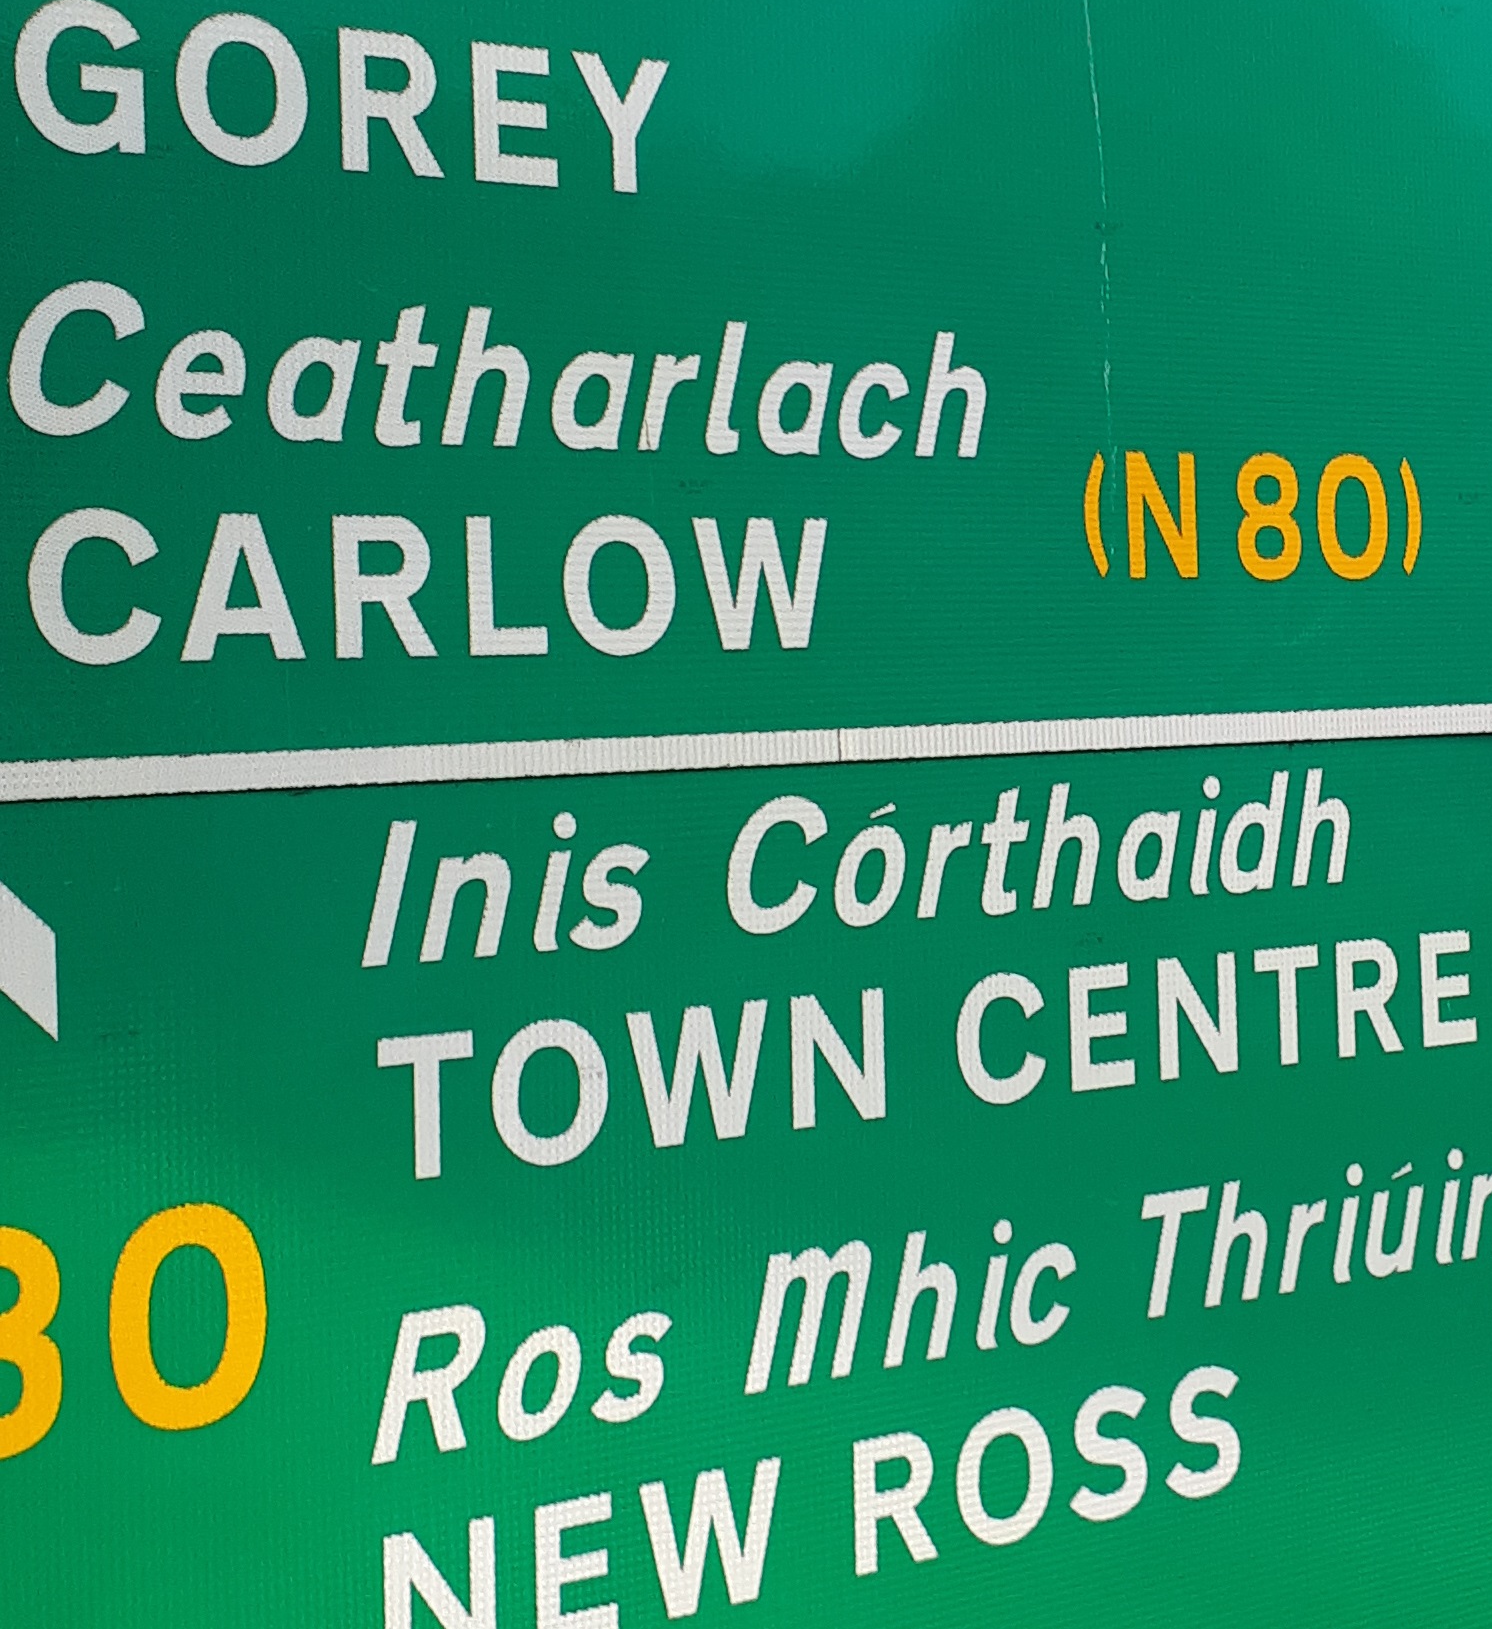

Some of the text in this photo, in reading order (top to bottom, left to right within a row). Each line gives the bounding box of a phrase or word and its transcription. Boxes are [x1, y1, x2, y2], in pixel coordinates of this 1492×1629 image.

[8, 280, 988, 460] Ceatharlach
[28, 508, 829, 666] CARLOW
[360, 768, 1352, 969] Inis Córthaidh
[377, 929, 1479, 1180] TOWN CENTRE
[371, 1305, 674, 1466] Ros
[382, 1365, 1242, 1629] NEW ROSS
